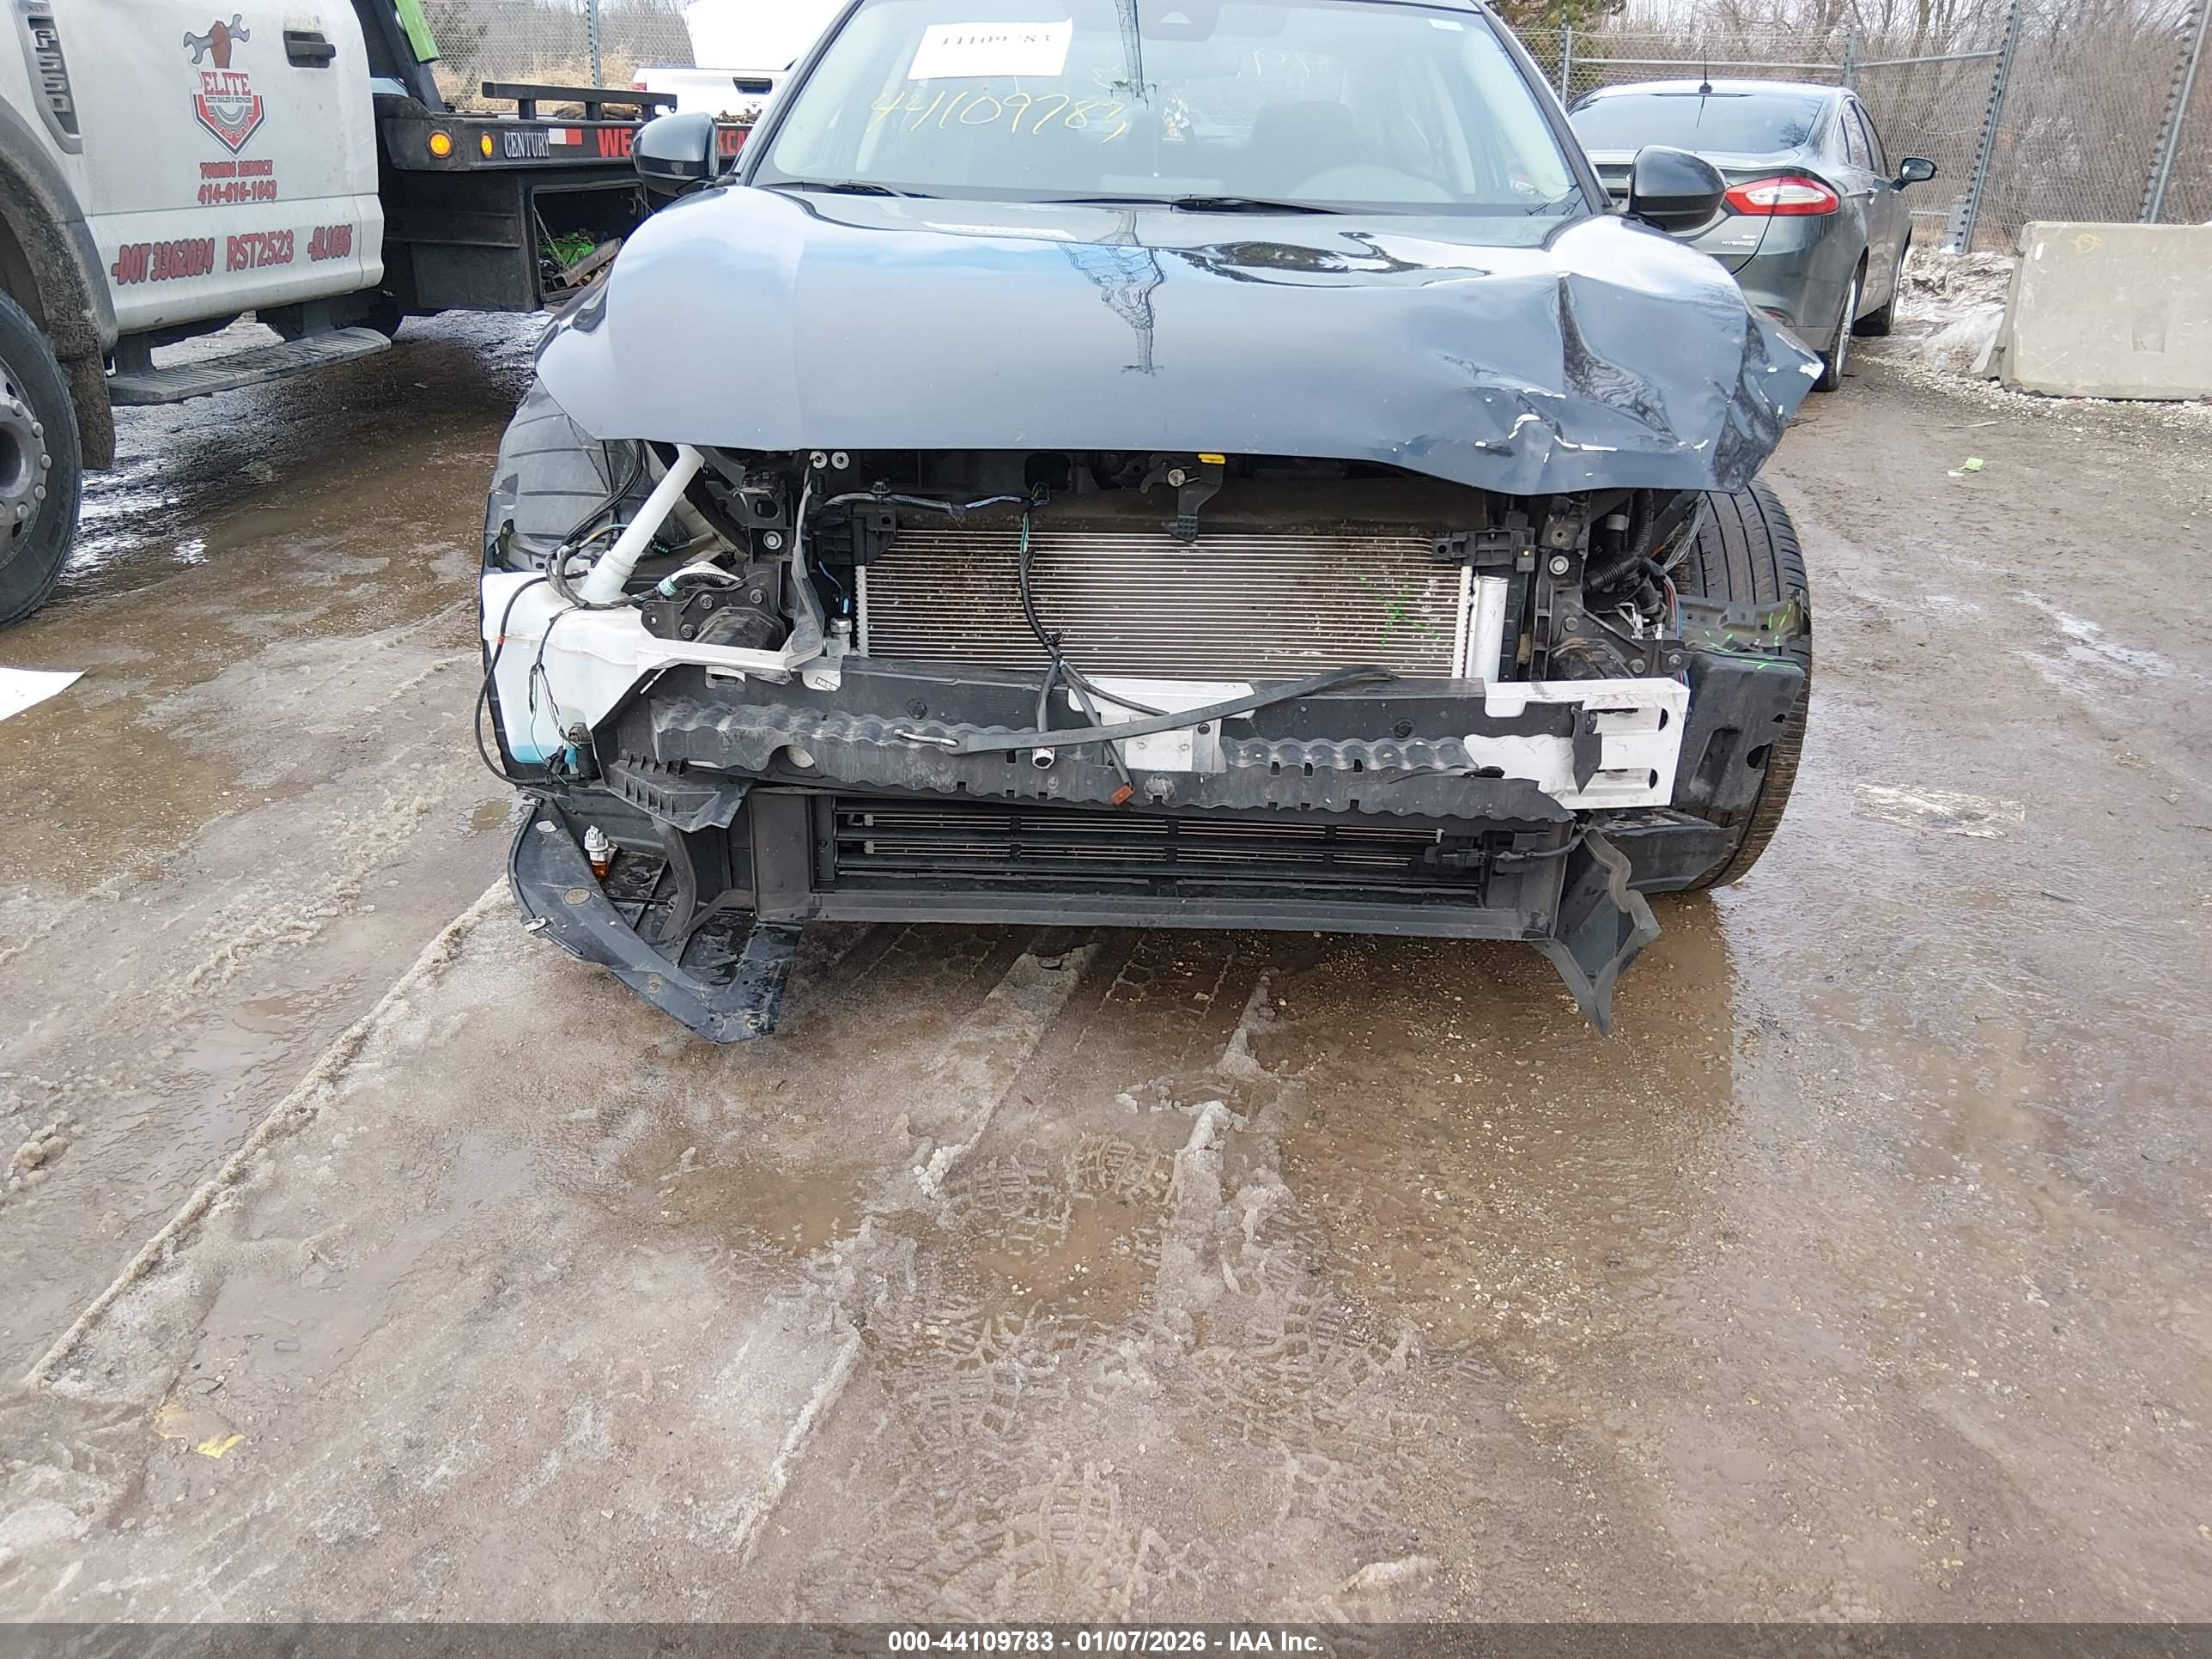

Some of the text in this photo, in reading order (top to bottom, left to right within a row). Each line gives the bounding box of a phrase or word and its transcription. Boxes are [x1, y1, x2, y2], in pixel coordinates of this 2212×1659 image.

[201, 71, 252, 95] ELITE
[503, 131, 550, 158] CENTURY
[200, 160, 272, 179] TOWING SERVICE
[226, 228, 295, 272] RST2523
